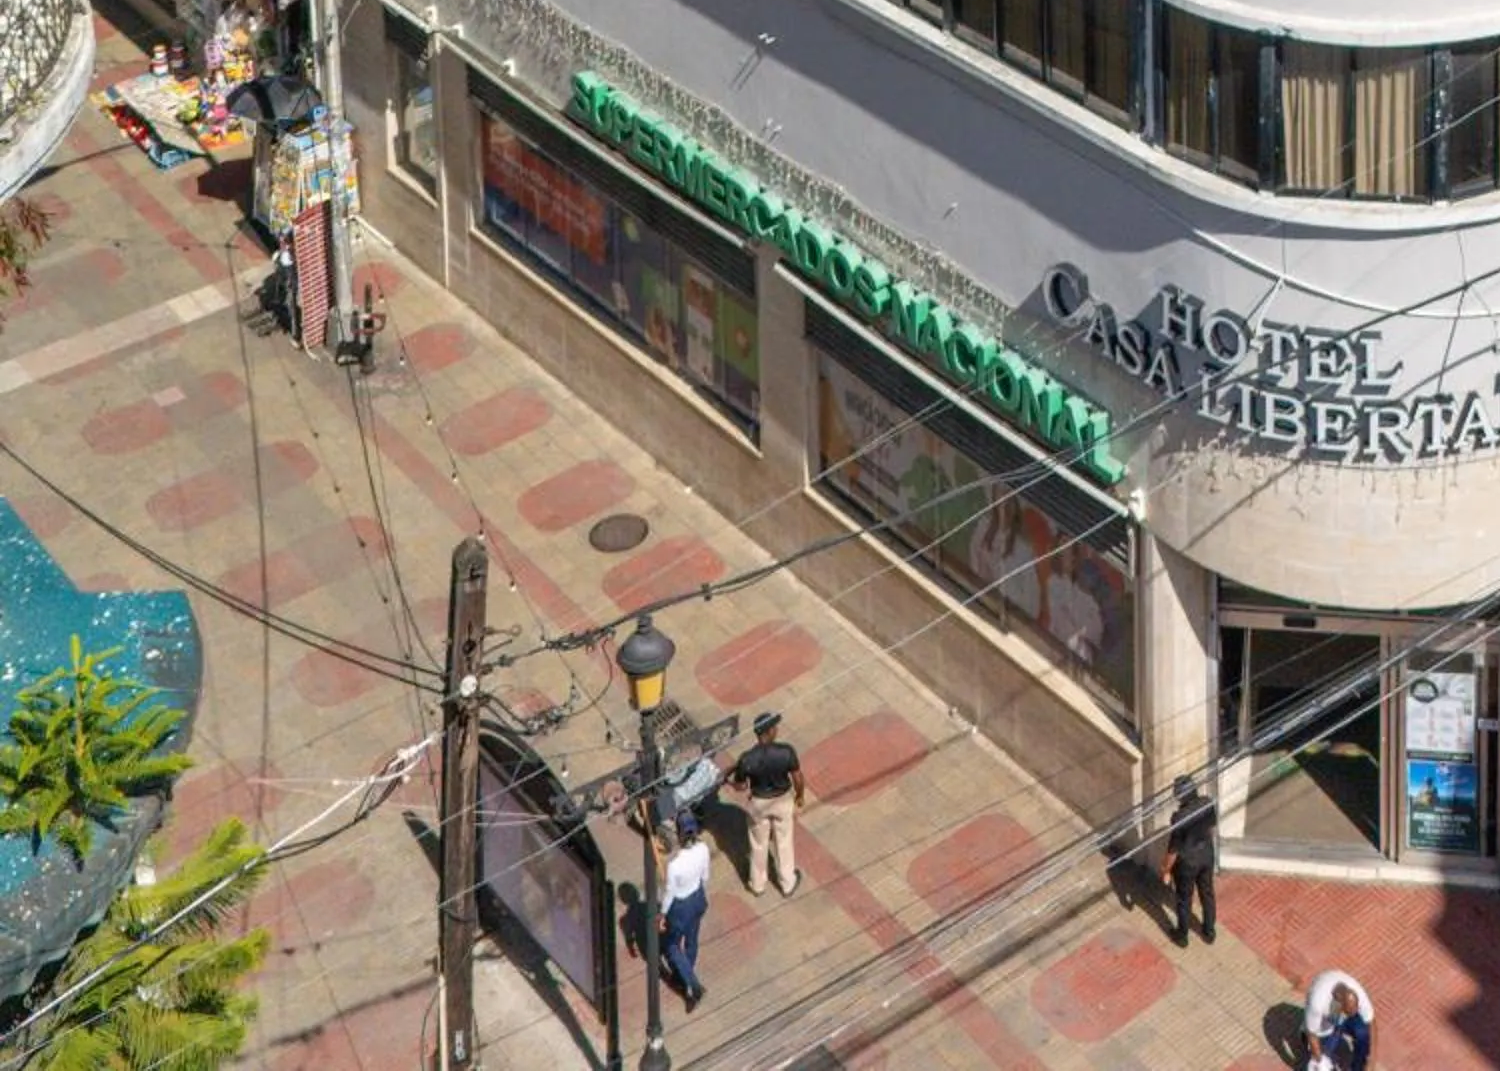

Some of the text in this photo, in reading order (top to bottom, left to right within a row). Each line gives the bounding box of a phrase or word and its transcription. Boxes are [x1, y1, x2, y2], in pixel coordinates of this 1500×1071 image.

[570, 71, 893, 317] SUPERMERCADOS
[890, 280, 1128, 484] NACIONAL
[1043, 263, 1187, 401] CASA
[1159, 285, 1403, 393] HOTEL
